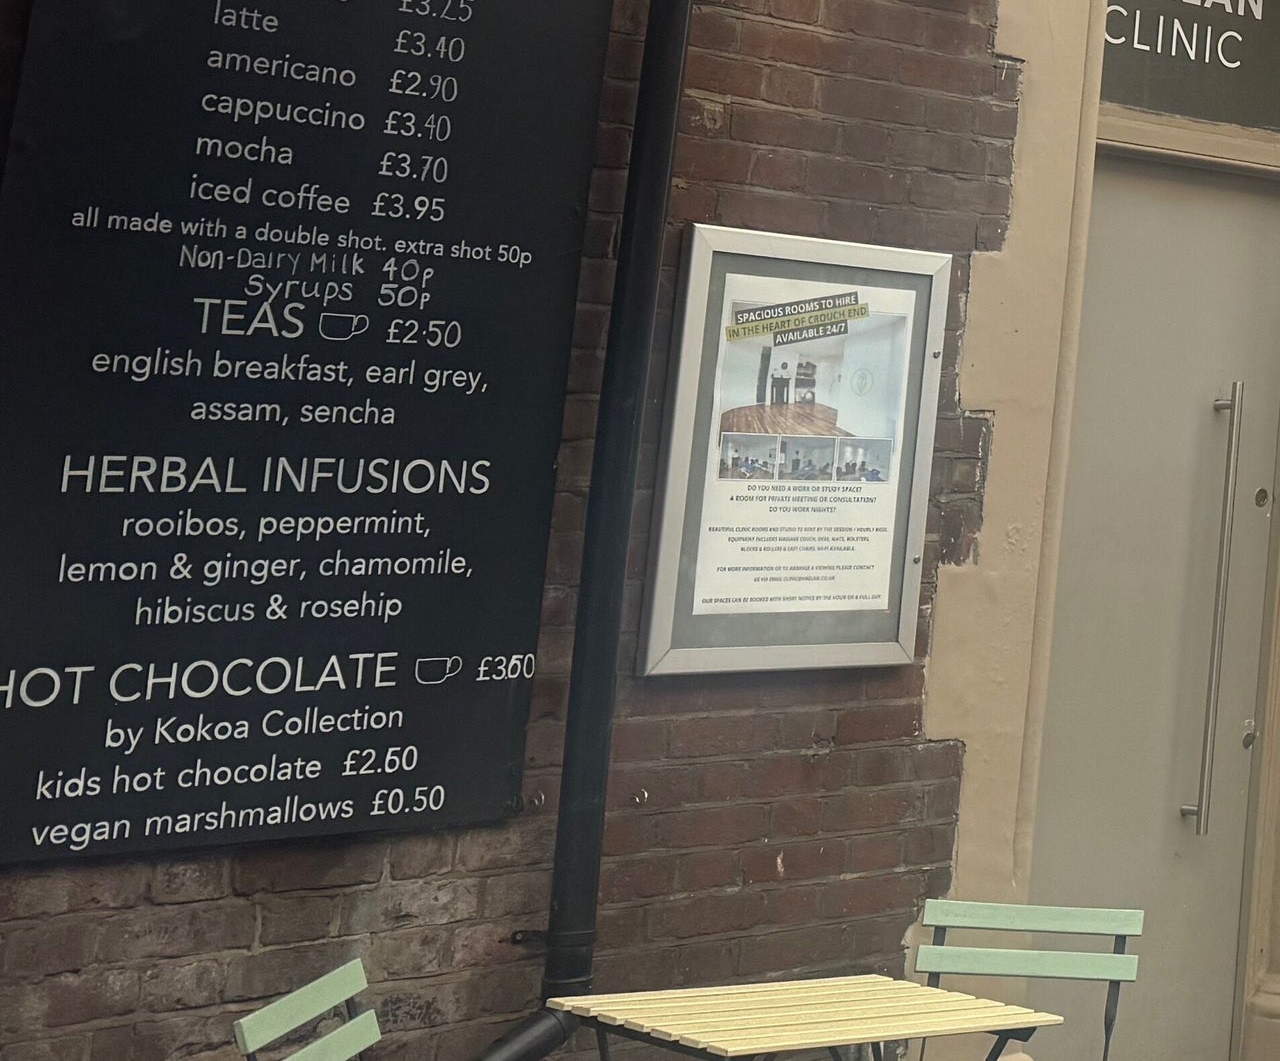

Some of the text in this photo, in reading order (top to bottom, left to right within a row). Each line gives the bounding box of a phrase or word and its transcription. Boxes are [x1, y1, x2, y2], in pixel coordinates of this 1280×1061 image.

[213, 0, 465, 62] latte £3.40
[1104, 5, 1243, 69] CLINIC
[207, 48, 458, 102] americano £2.90
[201, 92, 451, 141] cappuccino £3.40
[195, 136, 448, 183] mocha £3.70
[189, 174, 445, 222] iced coffee £3.95
[193, 298, 305, 339] TEAS
[737, 295, 857, 324] SPACIOUS ROOMS TO HIRE
[775, 323, 846, 344] AVAILABLE 24/7
[91, 347, 488, 395] english breakfast, earl grey,
[190, 399, 396, 426] assam, sencha
[60, 455, 491, 495] HERBAL INFUSIONS
[122, 511, 430, 542] rooibos, peppermint,
[58, 549, 473, 587] lemon & ginger, chamomile,
[135, 592, 402, 626] hibiscus & rosehip
[0, 666, 95, 709] HOT
[109, 651, 398, 705] CHOCOLATE
[104, 707, 403, 755] by Kokoa Collection
[36, 768, 101, 800] kids
[111, 764, 165, 794] hot
[177, 754, 322, 788] chocolate
[31, 785, 445, 851] vegan marshmallows £0.50
